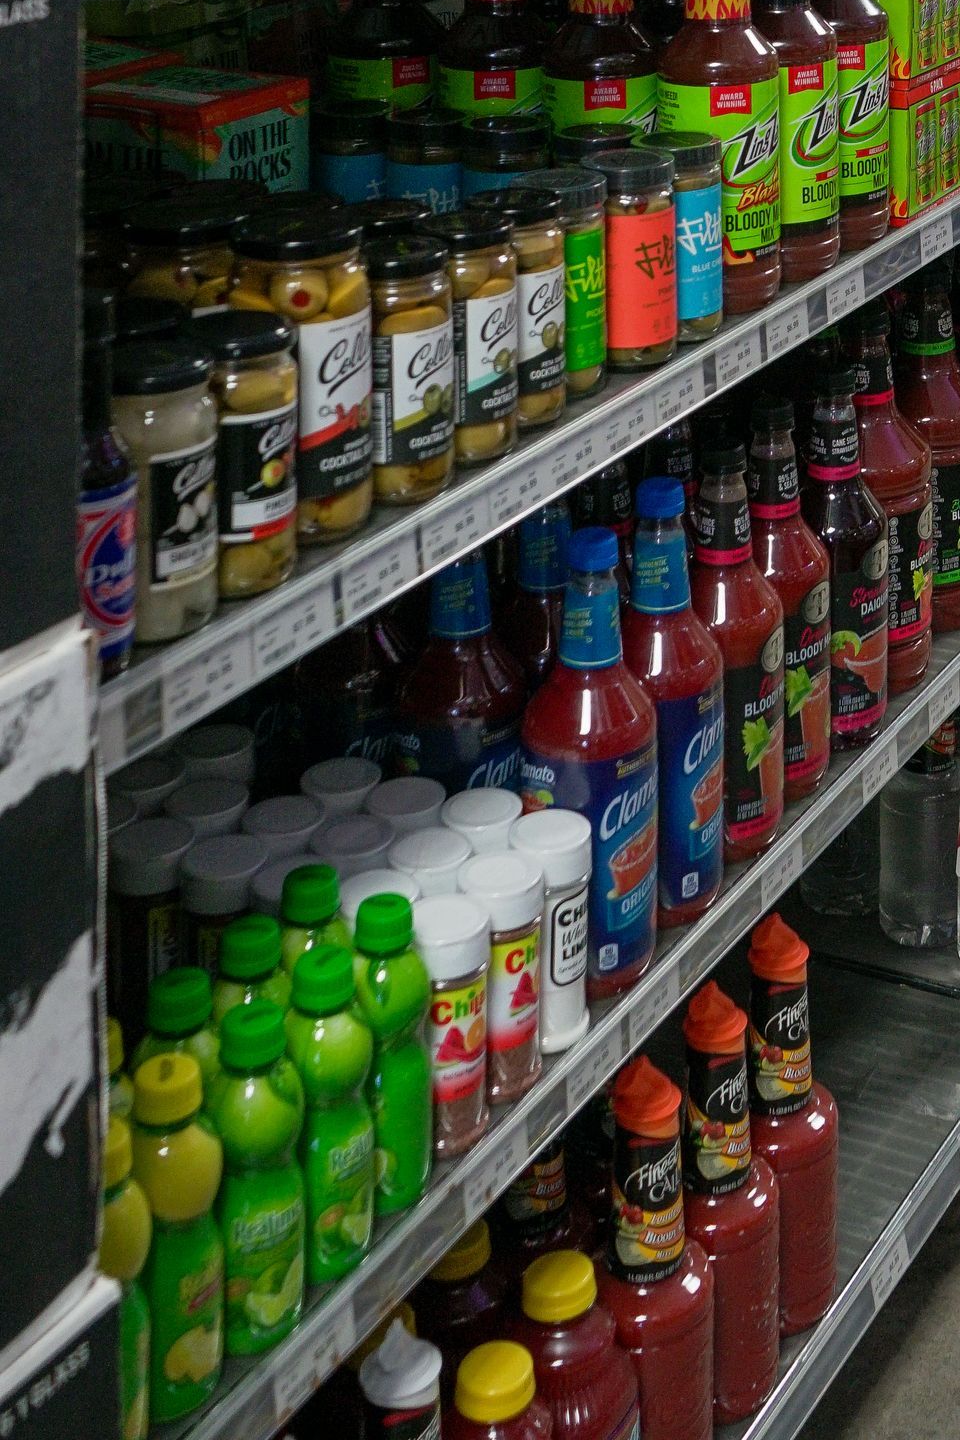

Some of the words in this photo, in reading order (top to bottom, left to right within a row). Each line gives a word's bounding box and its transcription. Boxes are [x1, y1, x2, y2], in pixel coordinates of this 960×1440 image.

[482, 77, 507, 86] AWARD
[794, 76, 820, 86] WINNING
[796, 70, 817, 79] AWARD
[590, 94, 621, 103] WINNING
[593, 87, 618, 95] AWARD
[719, 92, 744, 101] AWARD
[716, 99, 747, 109] WINNING
[229, 130, 256, 160] ON
[260, 117, 292, 147] THE
[230, 151, 292, 184] ROCKS
[841, 158, 879, 179] BLOODY
[873, 173, 885, 189] MIX
[725, 210, 771, 233] BLOODY
[760, 227, 775, 244] MIX
[692, 265, 710, 274] BLUE
[786, 643, 823, 665] BLOODY
[744, 691, 778, 717] BLOODY
[684, 717, 724, 776] Clam
